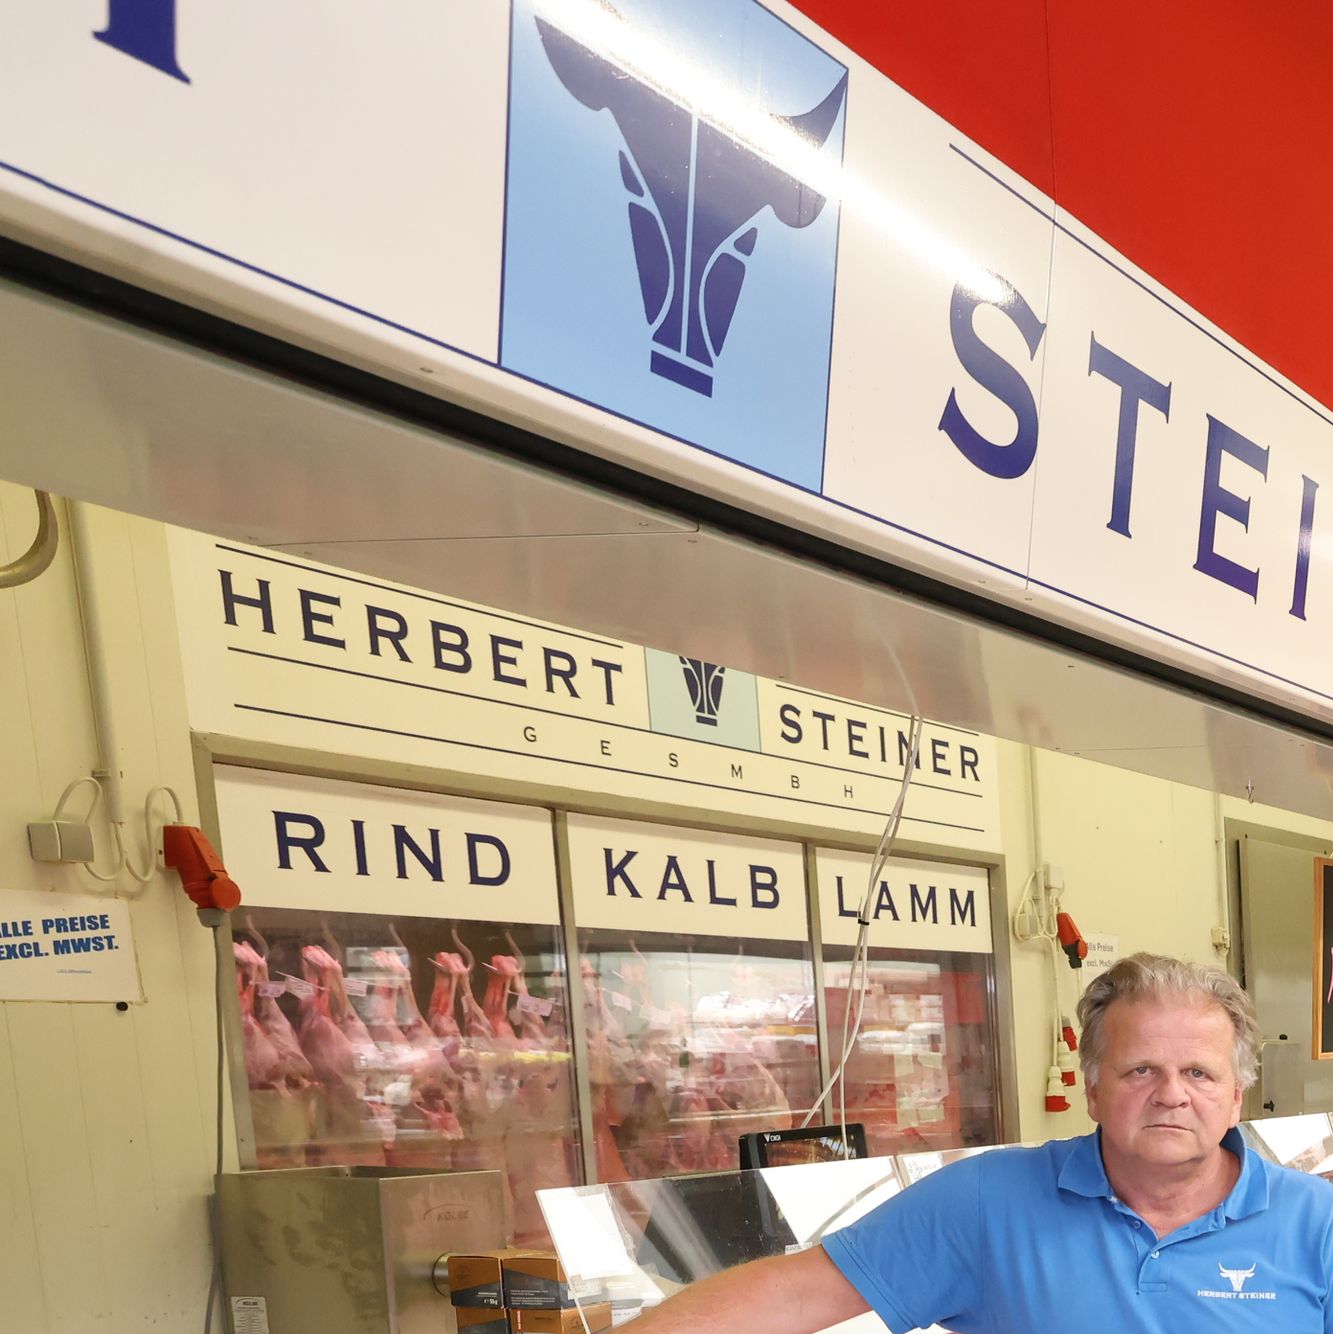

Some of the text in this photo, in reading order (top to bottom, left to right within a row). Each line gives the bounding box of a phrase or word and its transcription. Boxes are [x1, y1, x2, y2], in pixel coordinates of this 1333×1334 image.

[218, 569, 981, 782] HERBERT STEINER
[273, 810, 511, 886] RIND
[603, 847, 780, 910] KALB
[836, 875, 977, 927] LAMM
[42, 914, 110, 934] PREISE
[53, 935, 119, 955] MWST.
[1197, 1290, 1276, 1300] HERBERT STEINER
